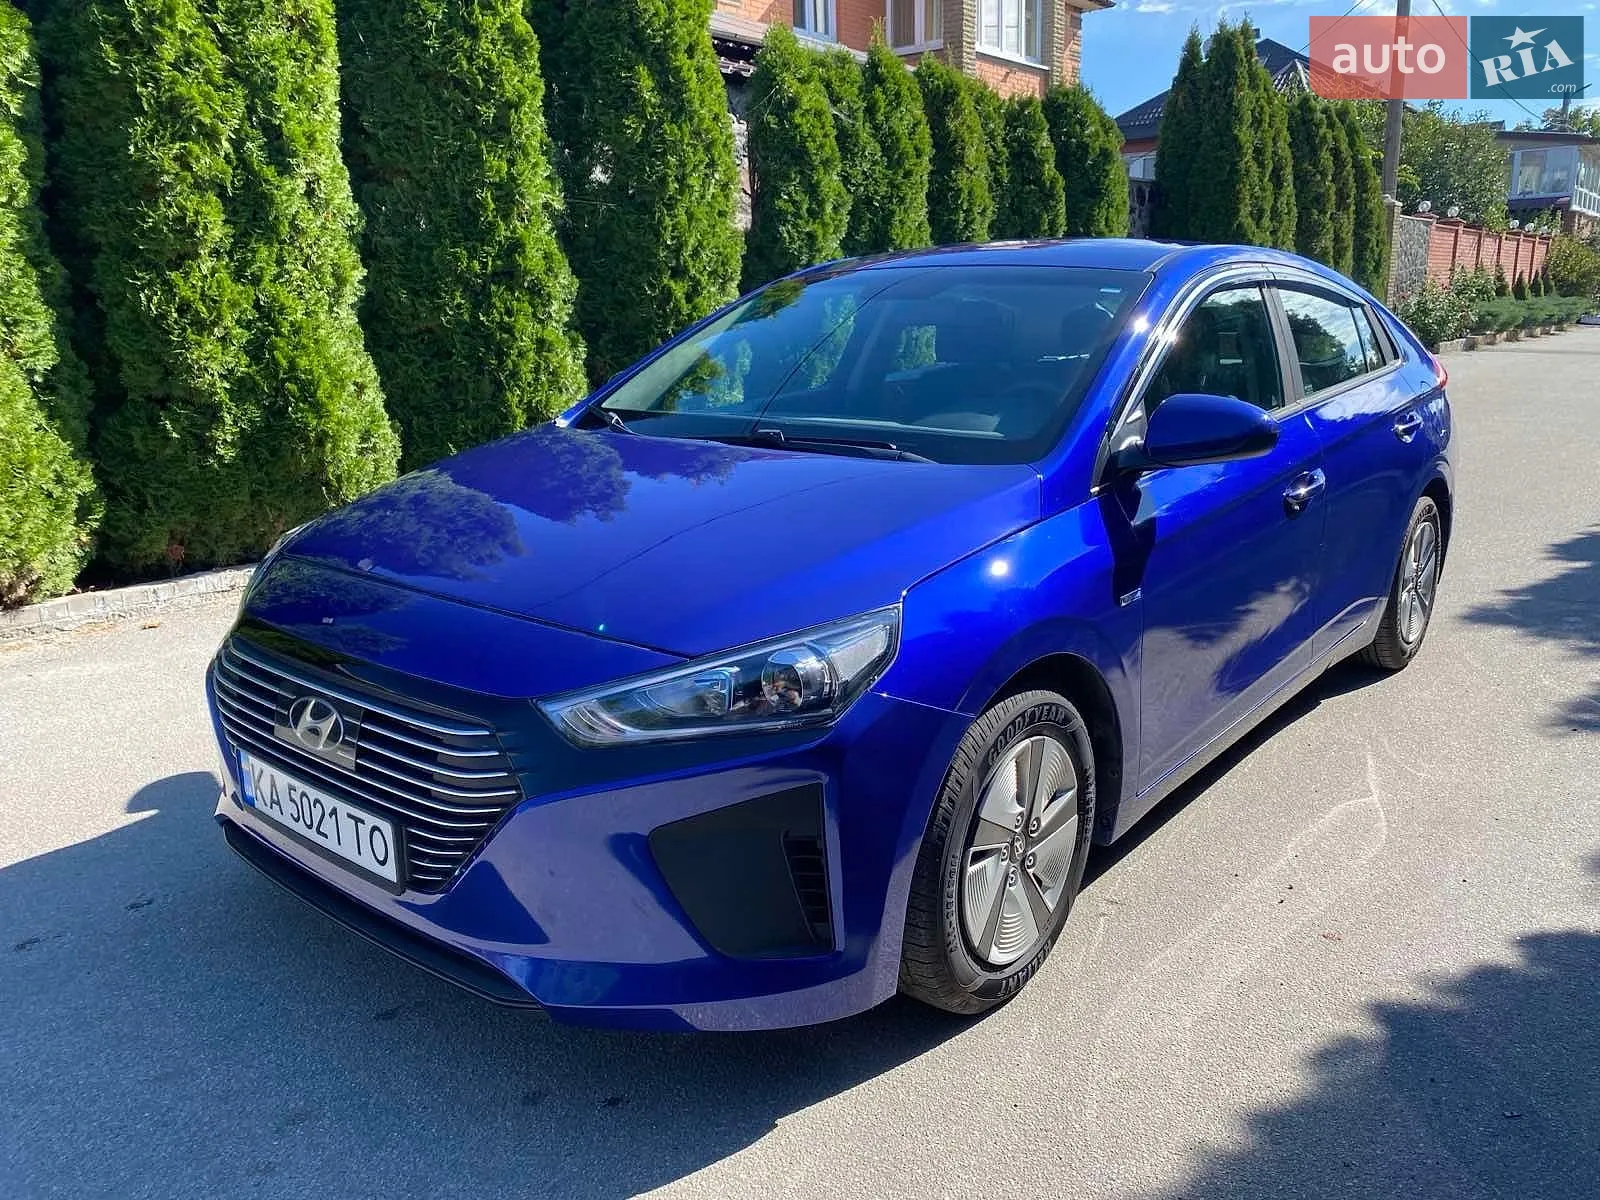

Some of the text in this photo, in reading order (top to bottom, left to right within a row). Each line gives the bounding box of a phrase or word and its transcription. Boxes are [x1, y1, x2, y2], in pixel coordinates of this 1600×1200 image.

[987, 704, 1065, 766] GOODYEAR
[251, 763, 389, 867] KA 5021 TO
